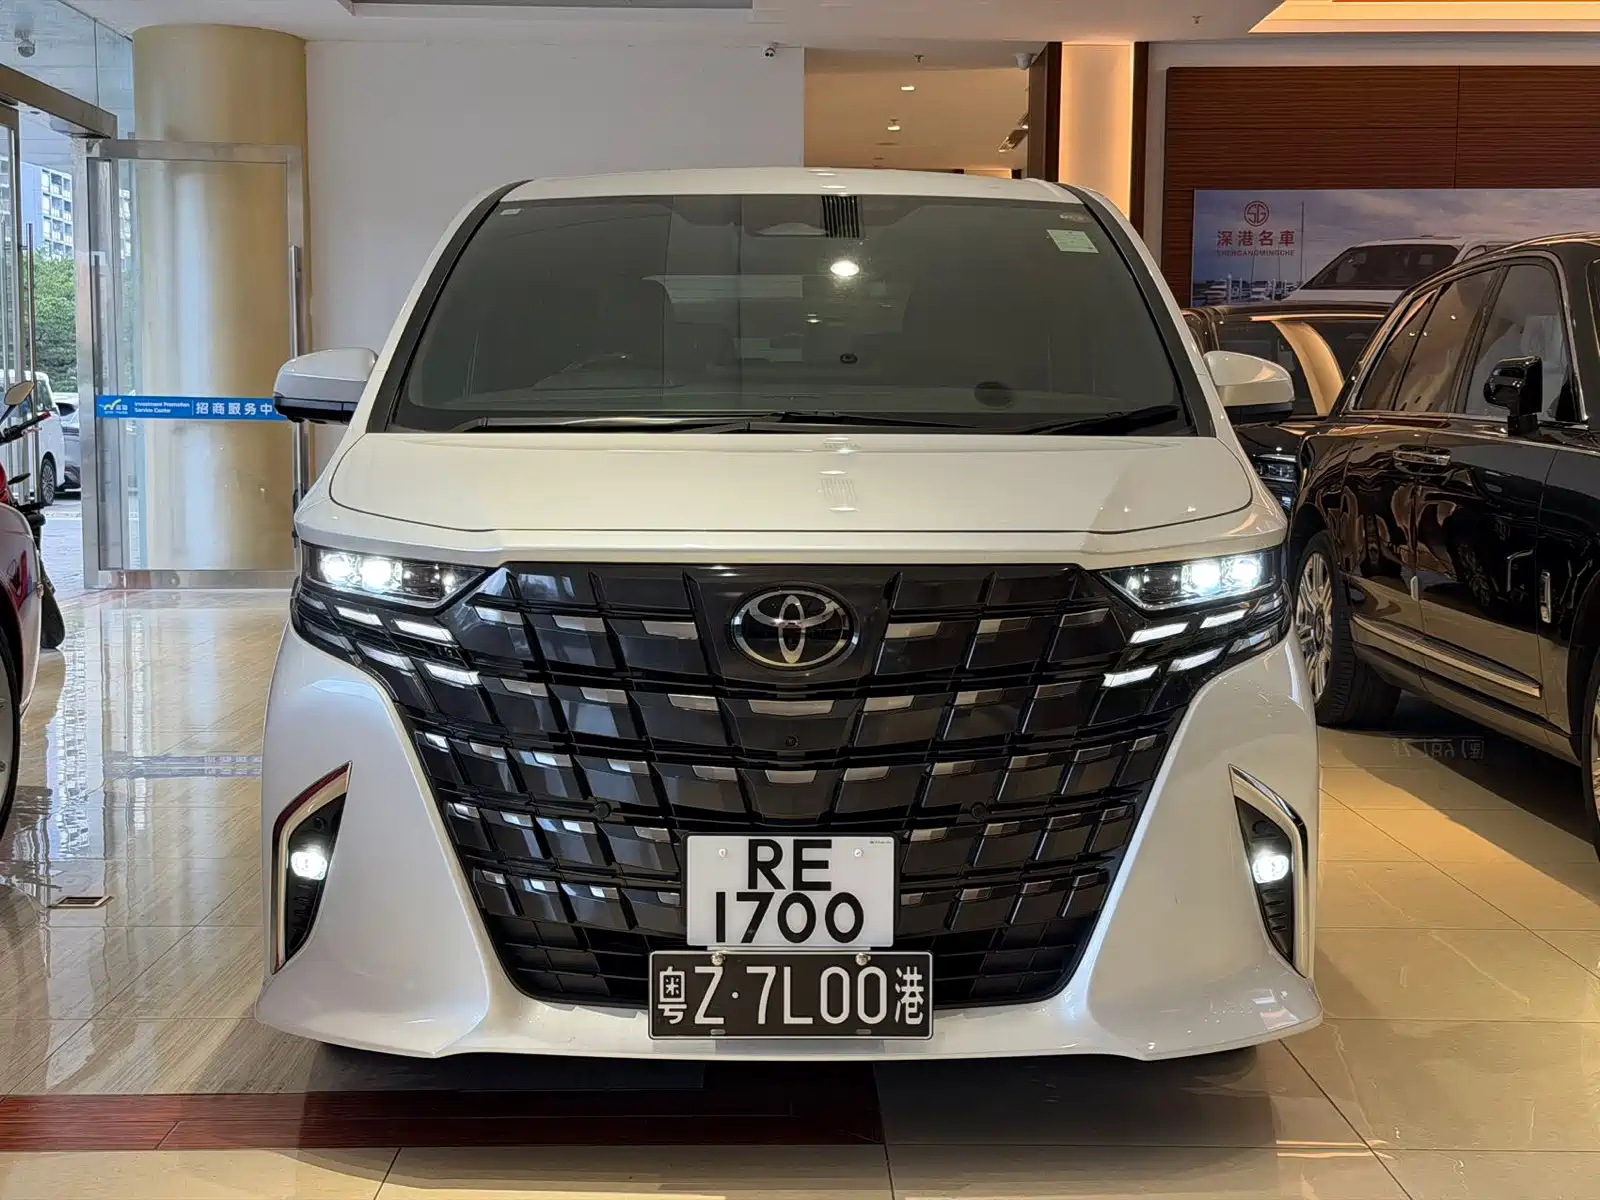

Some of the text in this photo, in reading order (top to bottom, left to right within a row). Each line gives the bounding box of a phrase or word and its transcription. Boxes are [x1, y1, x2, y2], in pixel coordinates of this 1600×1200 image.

[1217, 230, 1295, 247] 深港名車
[748, 838, 832, 891] RE
[715, 891, 864, 943] 1700
